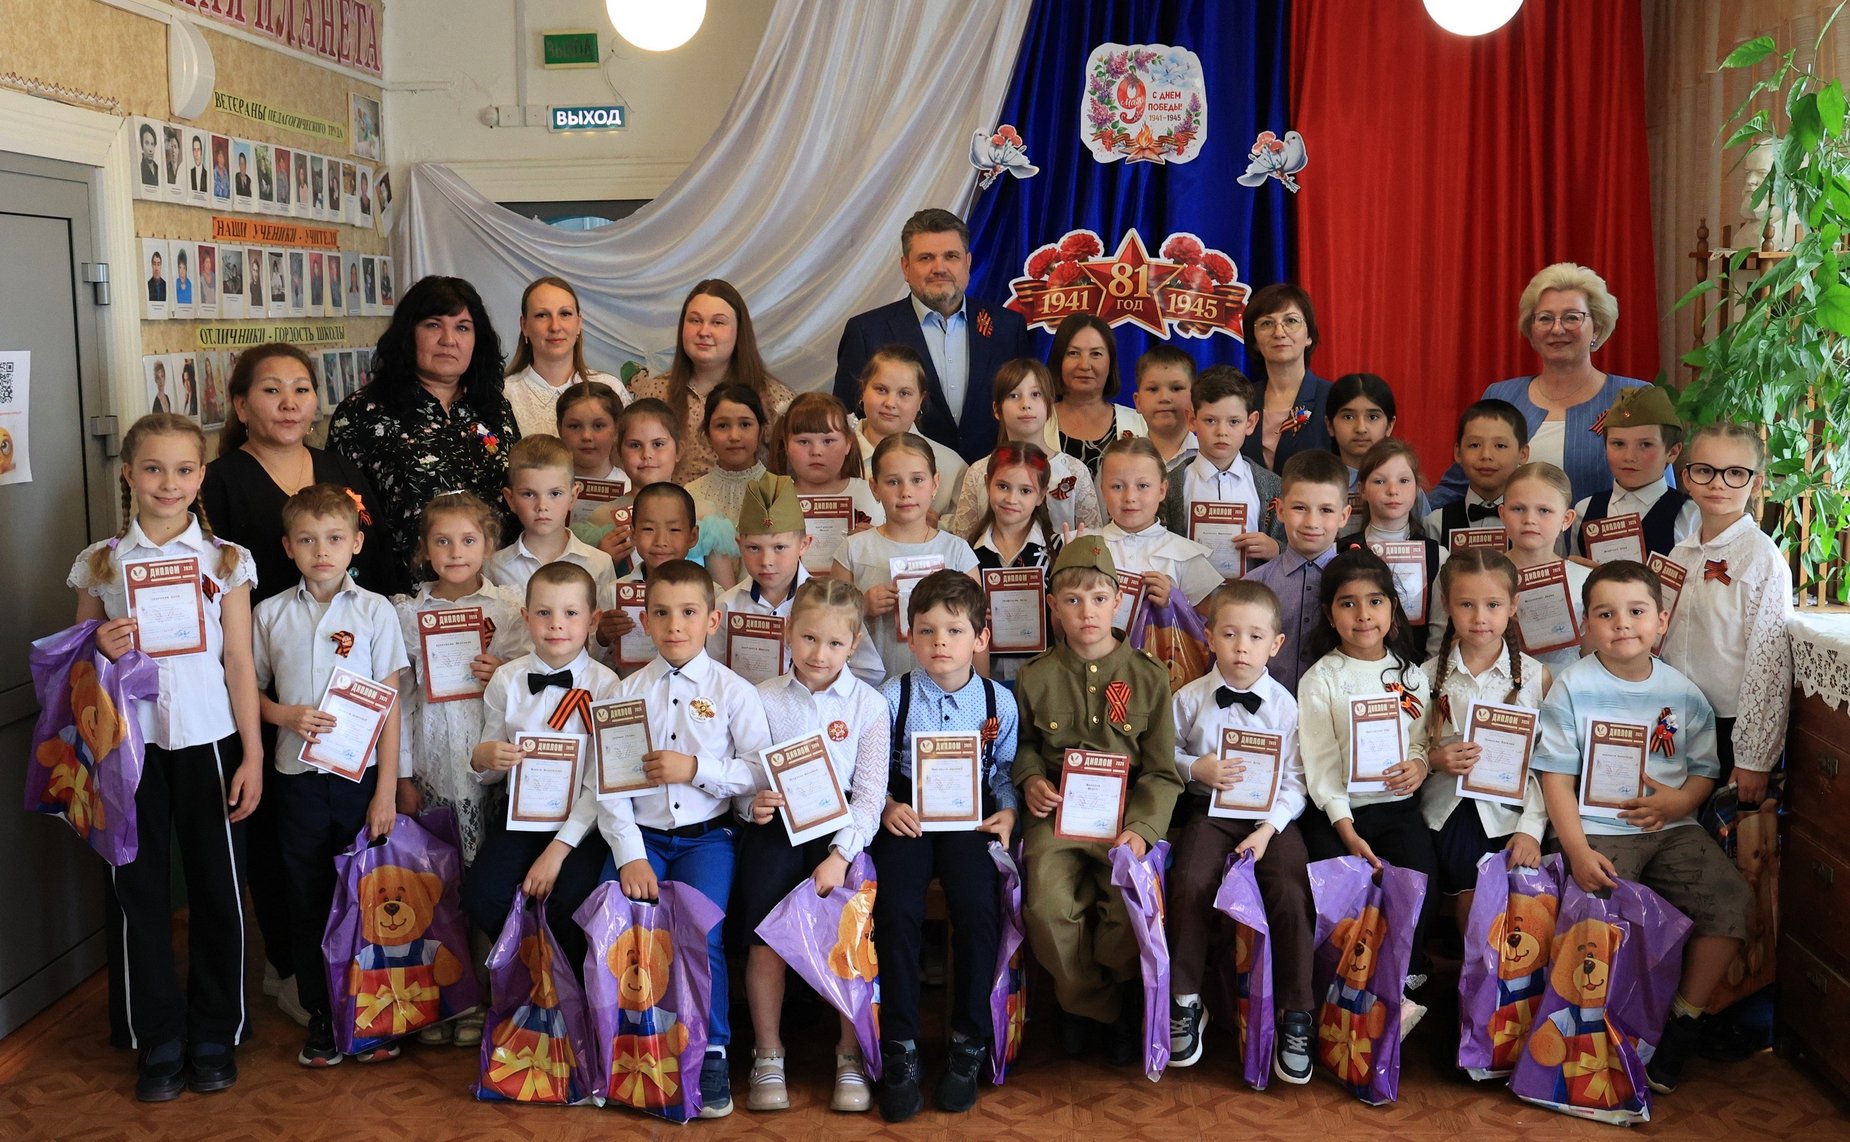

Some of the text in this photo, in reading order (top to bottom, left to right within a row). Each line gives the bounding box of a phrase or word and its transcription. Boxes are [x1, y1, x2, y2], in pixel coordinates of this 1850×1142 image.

[1117, 77, 1146, 124] 9
[1160, 91, 1181, 100] ДНЕМ
[1148, 103, 1183, 112] ПОБЕДЫ!
[214, 91, 344, 138] ВЕТЕРАНЫ ПЕДАГОГИЧЕСКОГО ТРУДА
[556, 110, 622, 126] ВЫХОД
[216, 220, 337, 246] НАШИ УЧЕНИКИ УЧИТЕЛЯ
[1108, 262, 1151, 298] 81
[1041, 290, 1090, 314] 1941
[1167, 292, 1218, 318] 1945
[200, 326, 345, 344] ОТЛИЧНИКИ ГОРДОСТЬ ШКОЛЫ
[814, 502, 837, 510] ДИПЛОМ
[1208, 508, 1232, 516] ДИПЛОМ
[1602, 520, 1626, 533] ДИПЛОМ
[1469, 534, 1492, 543] ДИПЛОМ
[1386, 547, 1410, 555] ДИПЛОМ
[150, 565, 180, 578] ДИПЛОМ
[1524, 568, 1550, 582] ДИПЛОМ
[1003, 574, 1027, 584] ДИПЛОМ
[439, 614, 466, 625] ДИПЛОМ
[746, 619, 770, 629] ДИПЛОМ
[351, 682, 378, 700] ДИПЛОМ
[610, 707, 632, 719] ДИПЛОМ
[1492, 713, 1518, 724] ДИПЛОМ
[1609, 728, 1632, 738] ДИПЛОМ
[1241, 736, 1265, 745] ДИПЛОМ
[538, 743, 563, 751] ДИПЛОМ
[936, 742, 960, 751] ДИПЛОМ
[785, 745, 810, 760] ДИПЛОМ
[1084, 757, 1112, 767] ДИПЛОМ
